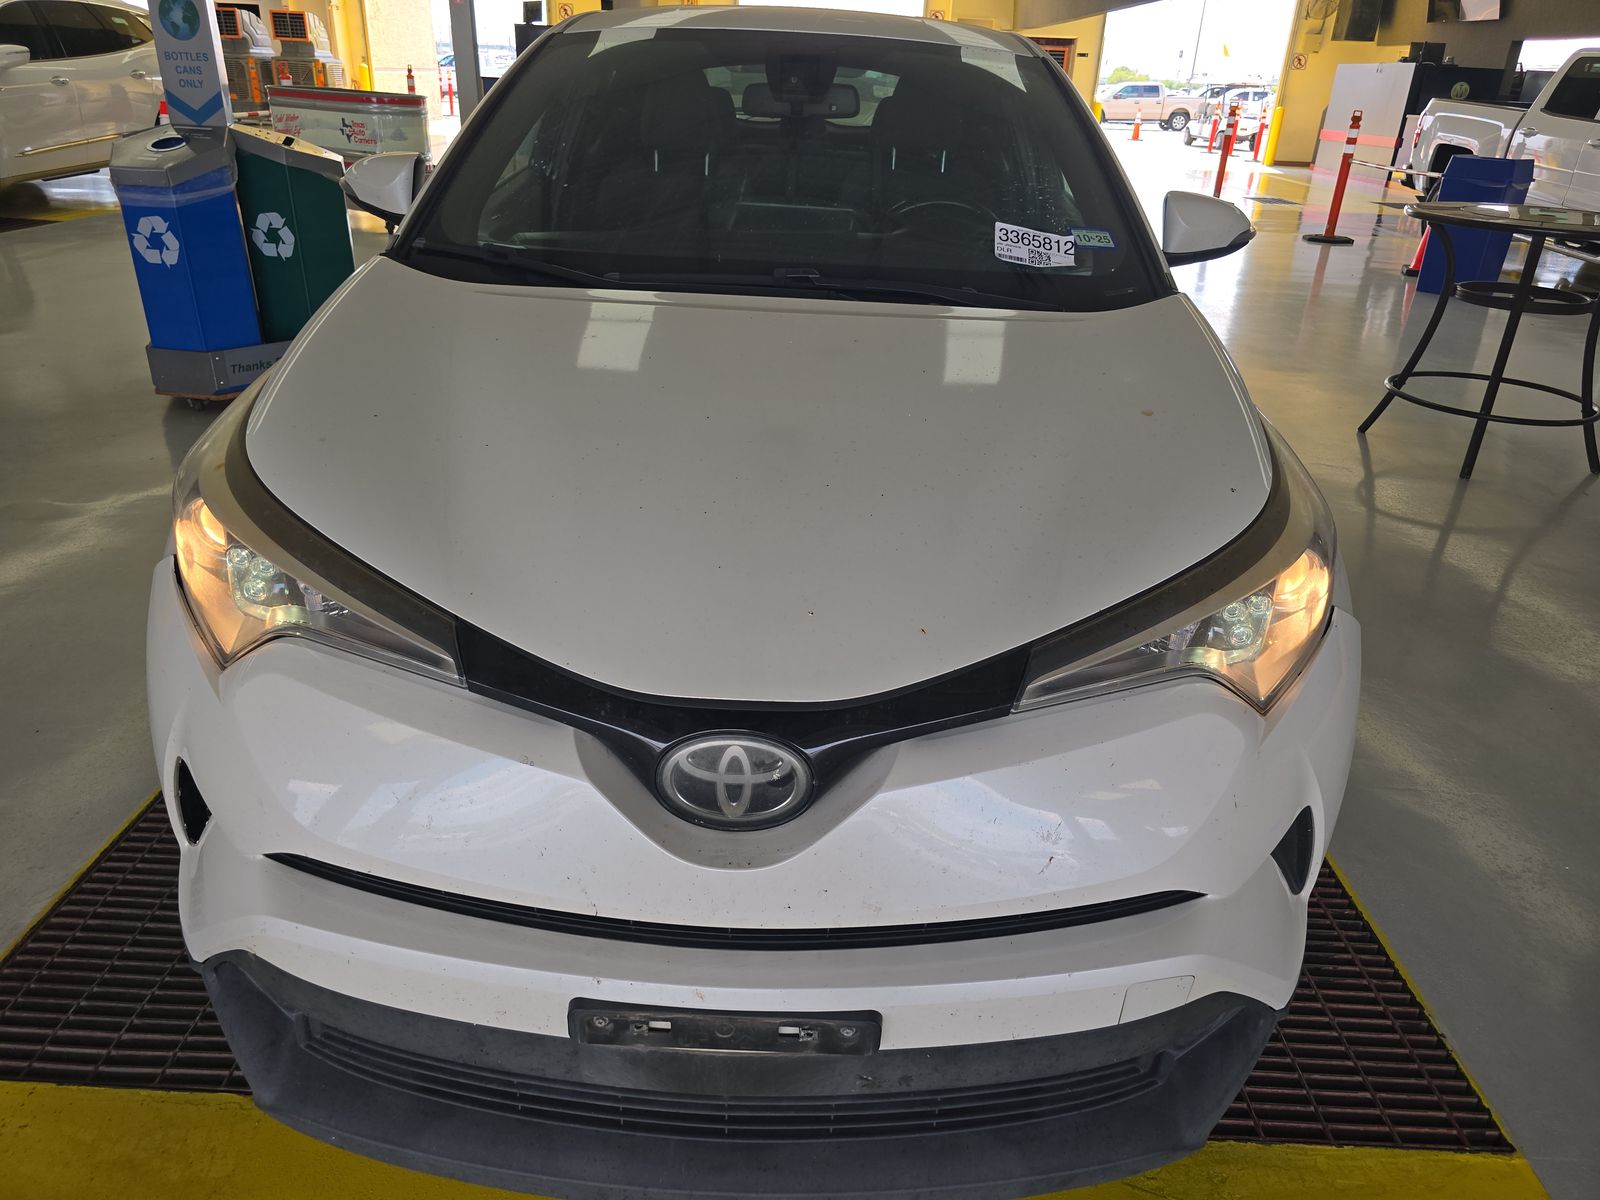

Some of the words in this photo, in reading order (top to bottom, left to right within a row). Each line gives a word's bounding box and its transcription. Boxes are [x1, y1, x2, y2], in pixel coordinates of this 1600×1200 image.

[164, 51, 209, 62] BOTTLES
[175, 65, 203, 76] CANS
[179, 79, 204, 89] ONLY
[998, 227, 1075, 256] 3365812
[230, 360, 272, 375] Thanks
